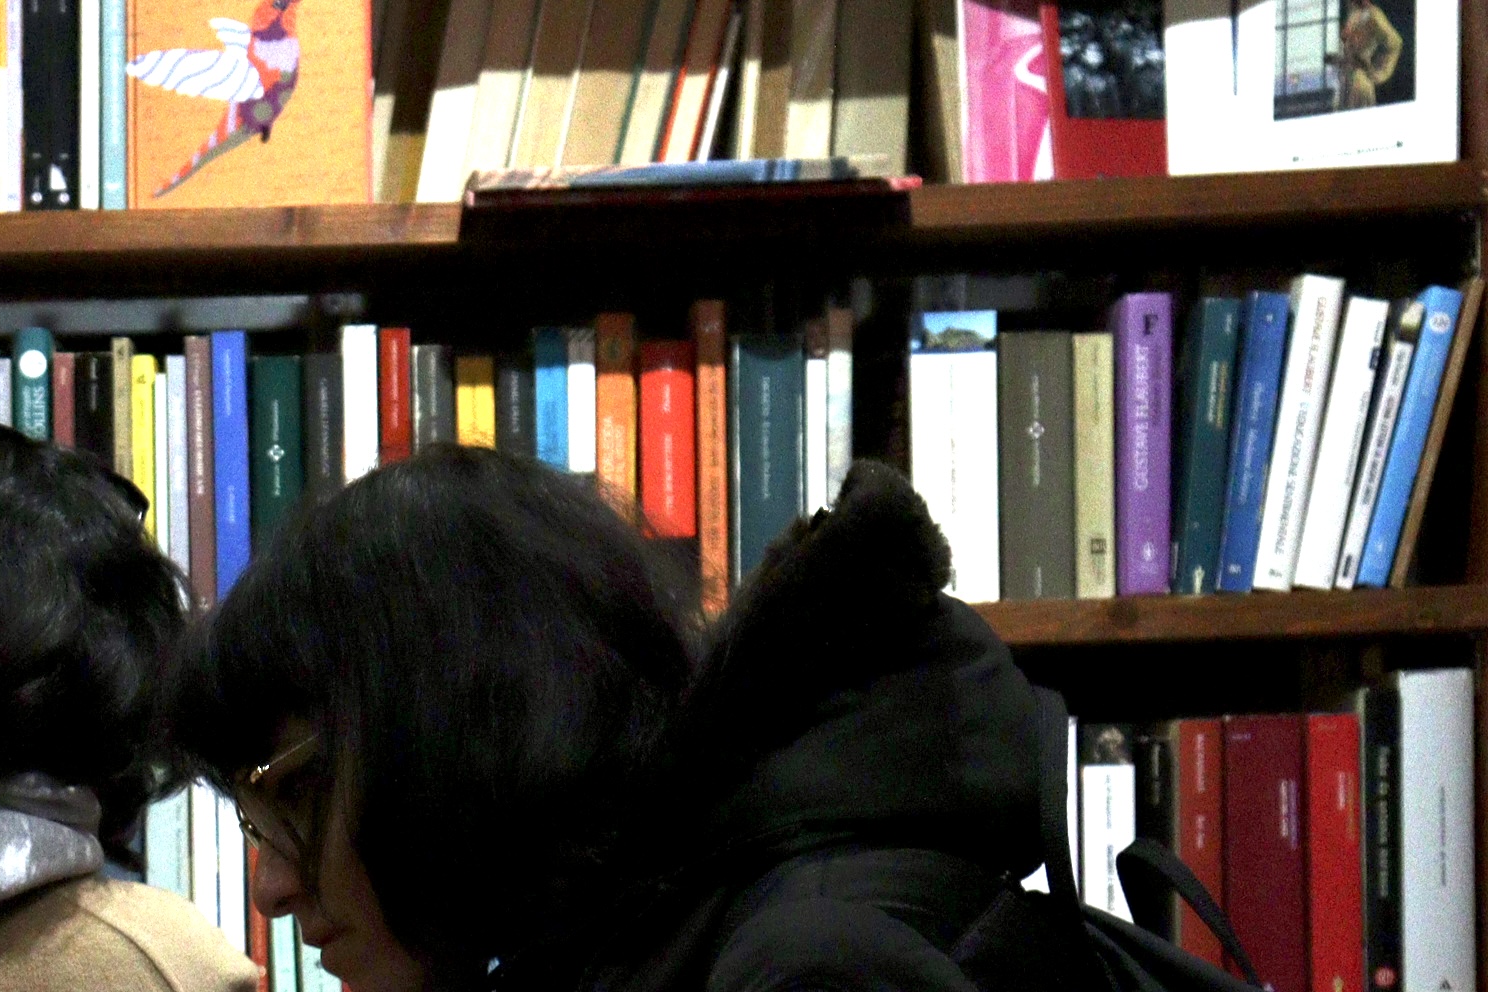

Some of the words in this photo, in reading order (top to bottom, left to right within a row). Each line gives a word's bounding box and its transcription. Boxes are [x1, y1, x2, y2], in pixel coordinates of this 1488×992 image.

[31, 385, 47, 434] OLLINS
[1132, 344, 1150, 418] FLAUBERT
[1132, 421, 1150, 490] GUSTAVE
